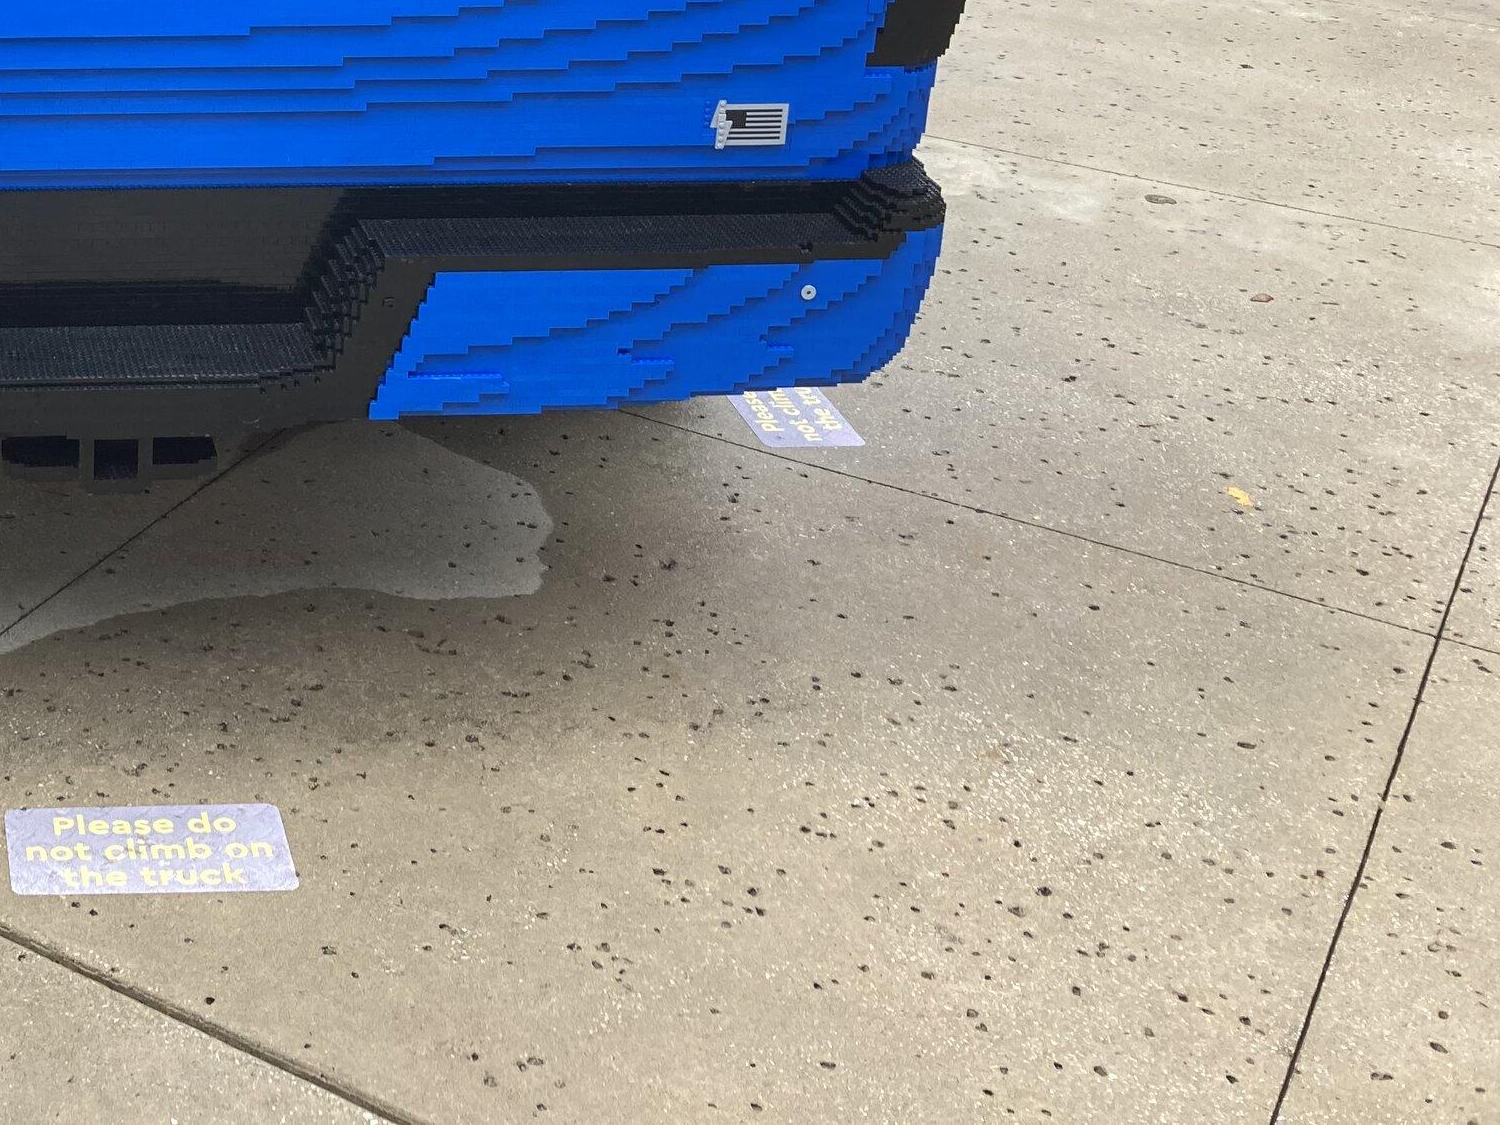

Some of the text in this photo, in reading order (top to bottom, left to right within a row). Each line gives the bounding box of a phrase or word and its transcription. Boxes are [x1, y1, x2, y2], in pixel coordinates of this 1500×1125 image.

[768, 388, 823, 442] not clim
[794, 387, 843, 431] the tru
[52, 811, 237, 836] Please do
[25, 836, 273, 862] not climb on
[61, 862, 248, 888] the truck
